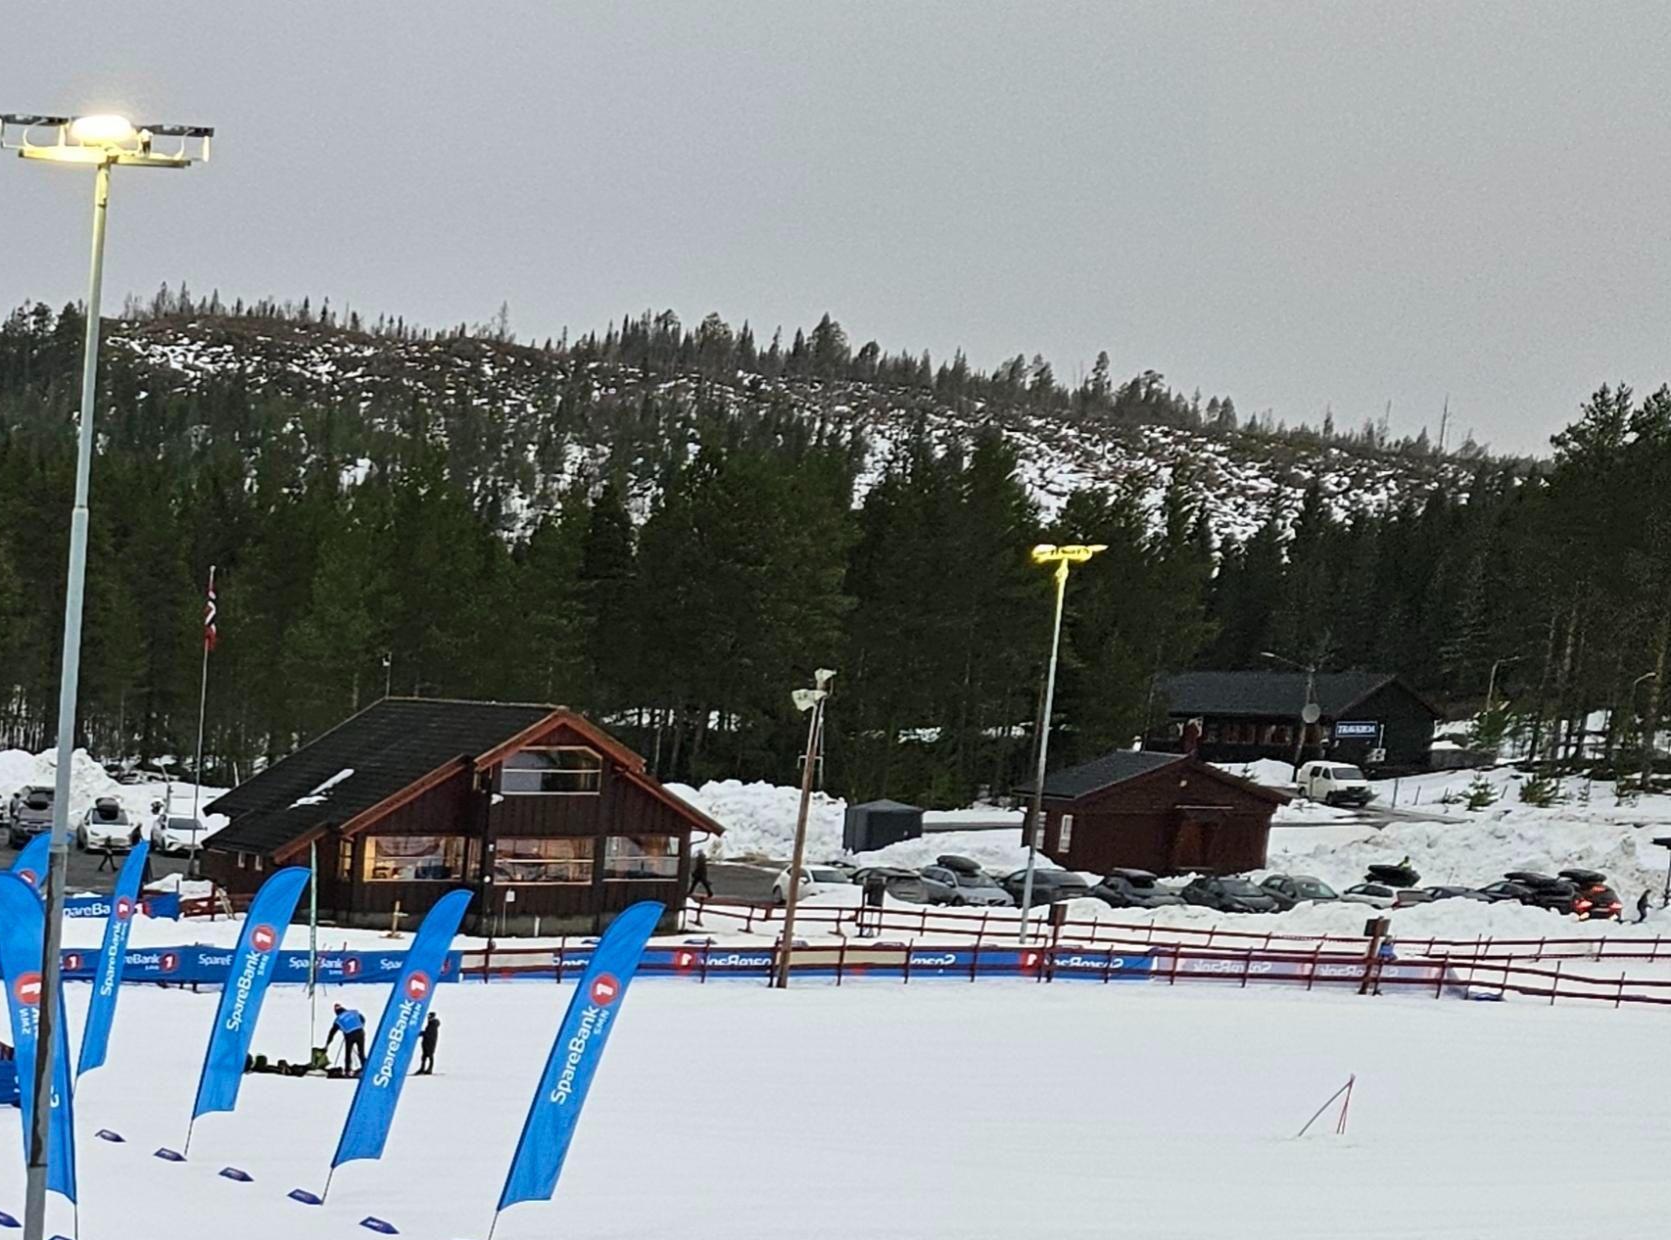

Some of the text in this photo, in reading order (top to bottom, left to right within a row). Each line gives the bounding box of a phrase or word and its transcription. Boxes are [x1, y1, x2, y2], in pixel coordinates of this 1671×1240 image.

[101, 923, 122, 997] SpareBank
[226, 932, 272, 1032] SpareBank 1
[373, 980, 426, 1088] SpareBank 1
[409, 1003, 421, 1028] SMN
[550, 1004, 600, 1105] SpareBank
[596, 983, 614, 996] 1
[593, 1009, 610, 1036] SMN
